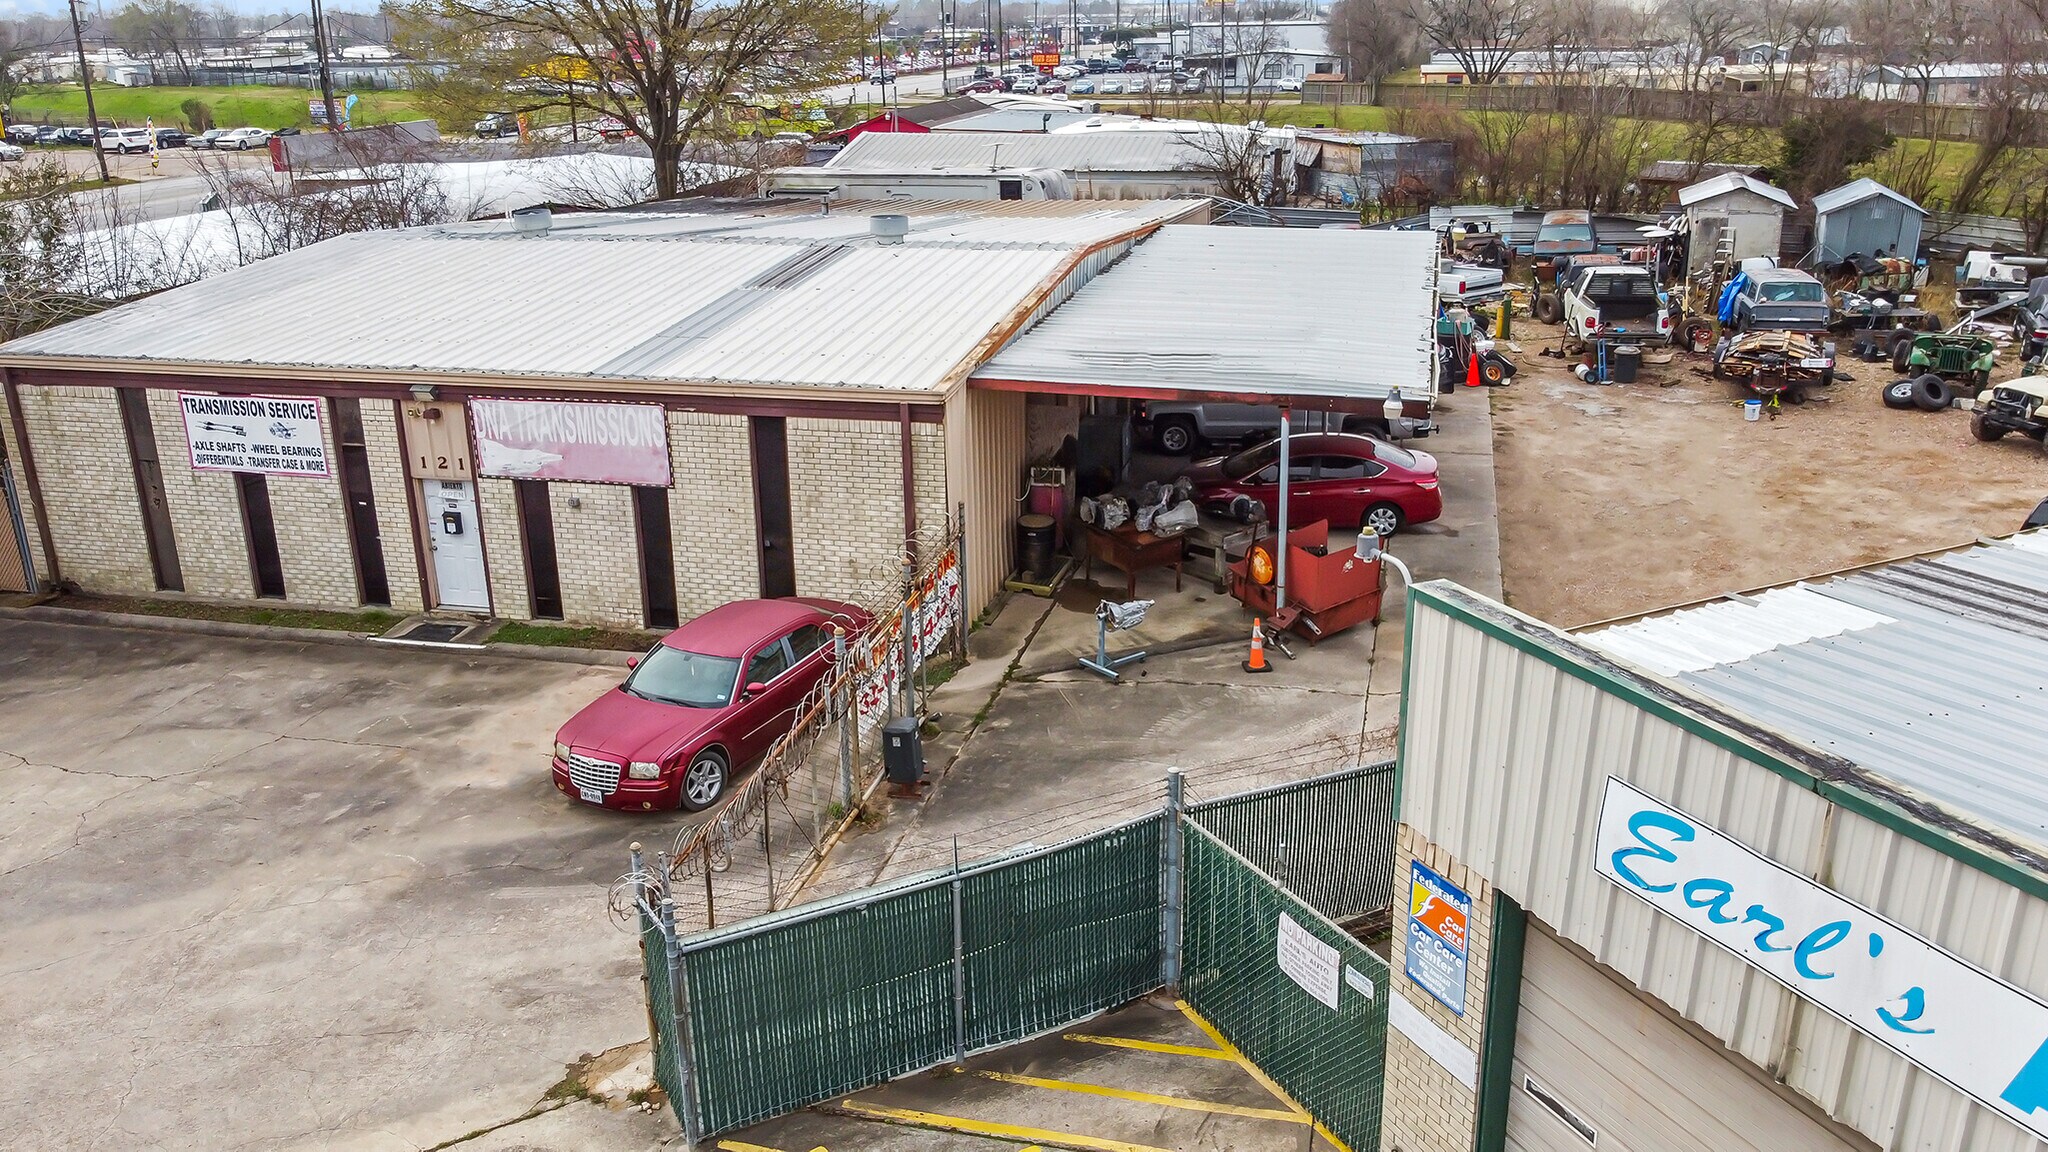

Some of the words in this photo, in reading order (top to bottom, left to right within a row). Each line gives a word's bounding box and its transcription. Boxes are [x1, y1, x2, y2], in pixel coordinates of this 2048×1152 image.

[183, 398, 266, 417] TRANSMISSION
[269, 402, 317, 420] SERVICE
[474, 402, 511, 438] DNA
[516, 406, 664, 447] TRANSMISSIONS
[193, 441, 215, 451] -AXLE
[216, 442, 246, 453] SHAFTS
[251, 444, 280, 455] -WHEEL
[282, 446, 322, 458] BEARINGS
[195, 454, 244, 467] -DIFFERENTIALS
[247, 456, 280, 469] -TRANSFER
[282, 459, 298, 470] CASE
[300, 460, 305, 470] &
[306, 460, 325, 472] MORE
[1412, 870, 1468, 914] Federated
[1445, 916, 1465, 933] Car
[1611, 810, 1935, 1034] Earl's
[1282, 915, 1294, 935] NO
[1297, 930, 1335, 965] PARKING
[1439, 923, 1464, 945] Care
[1410, 922, 1433, 944] Car
[1433, 940, 1463, 969] Care
[1310, 958, 1329, 975] AUTO
[1415, 940, 1454, 975] Center
[1418, 959, 1429, 971] We
[1408, 966, 1441, 998] Federated
[1442, 992, 1461, 1011] Parts
[1423, 971, 1446, 993] Quality
